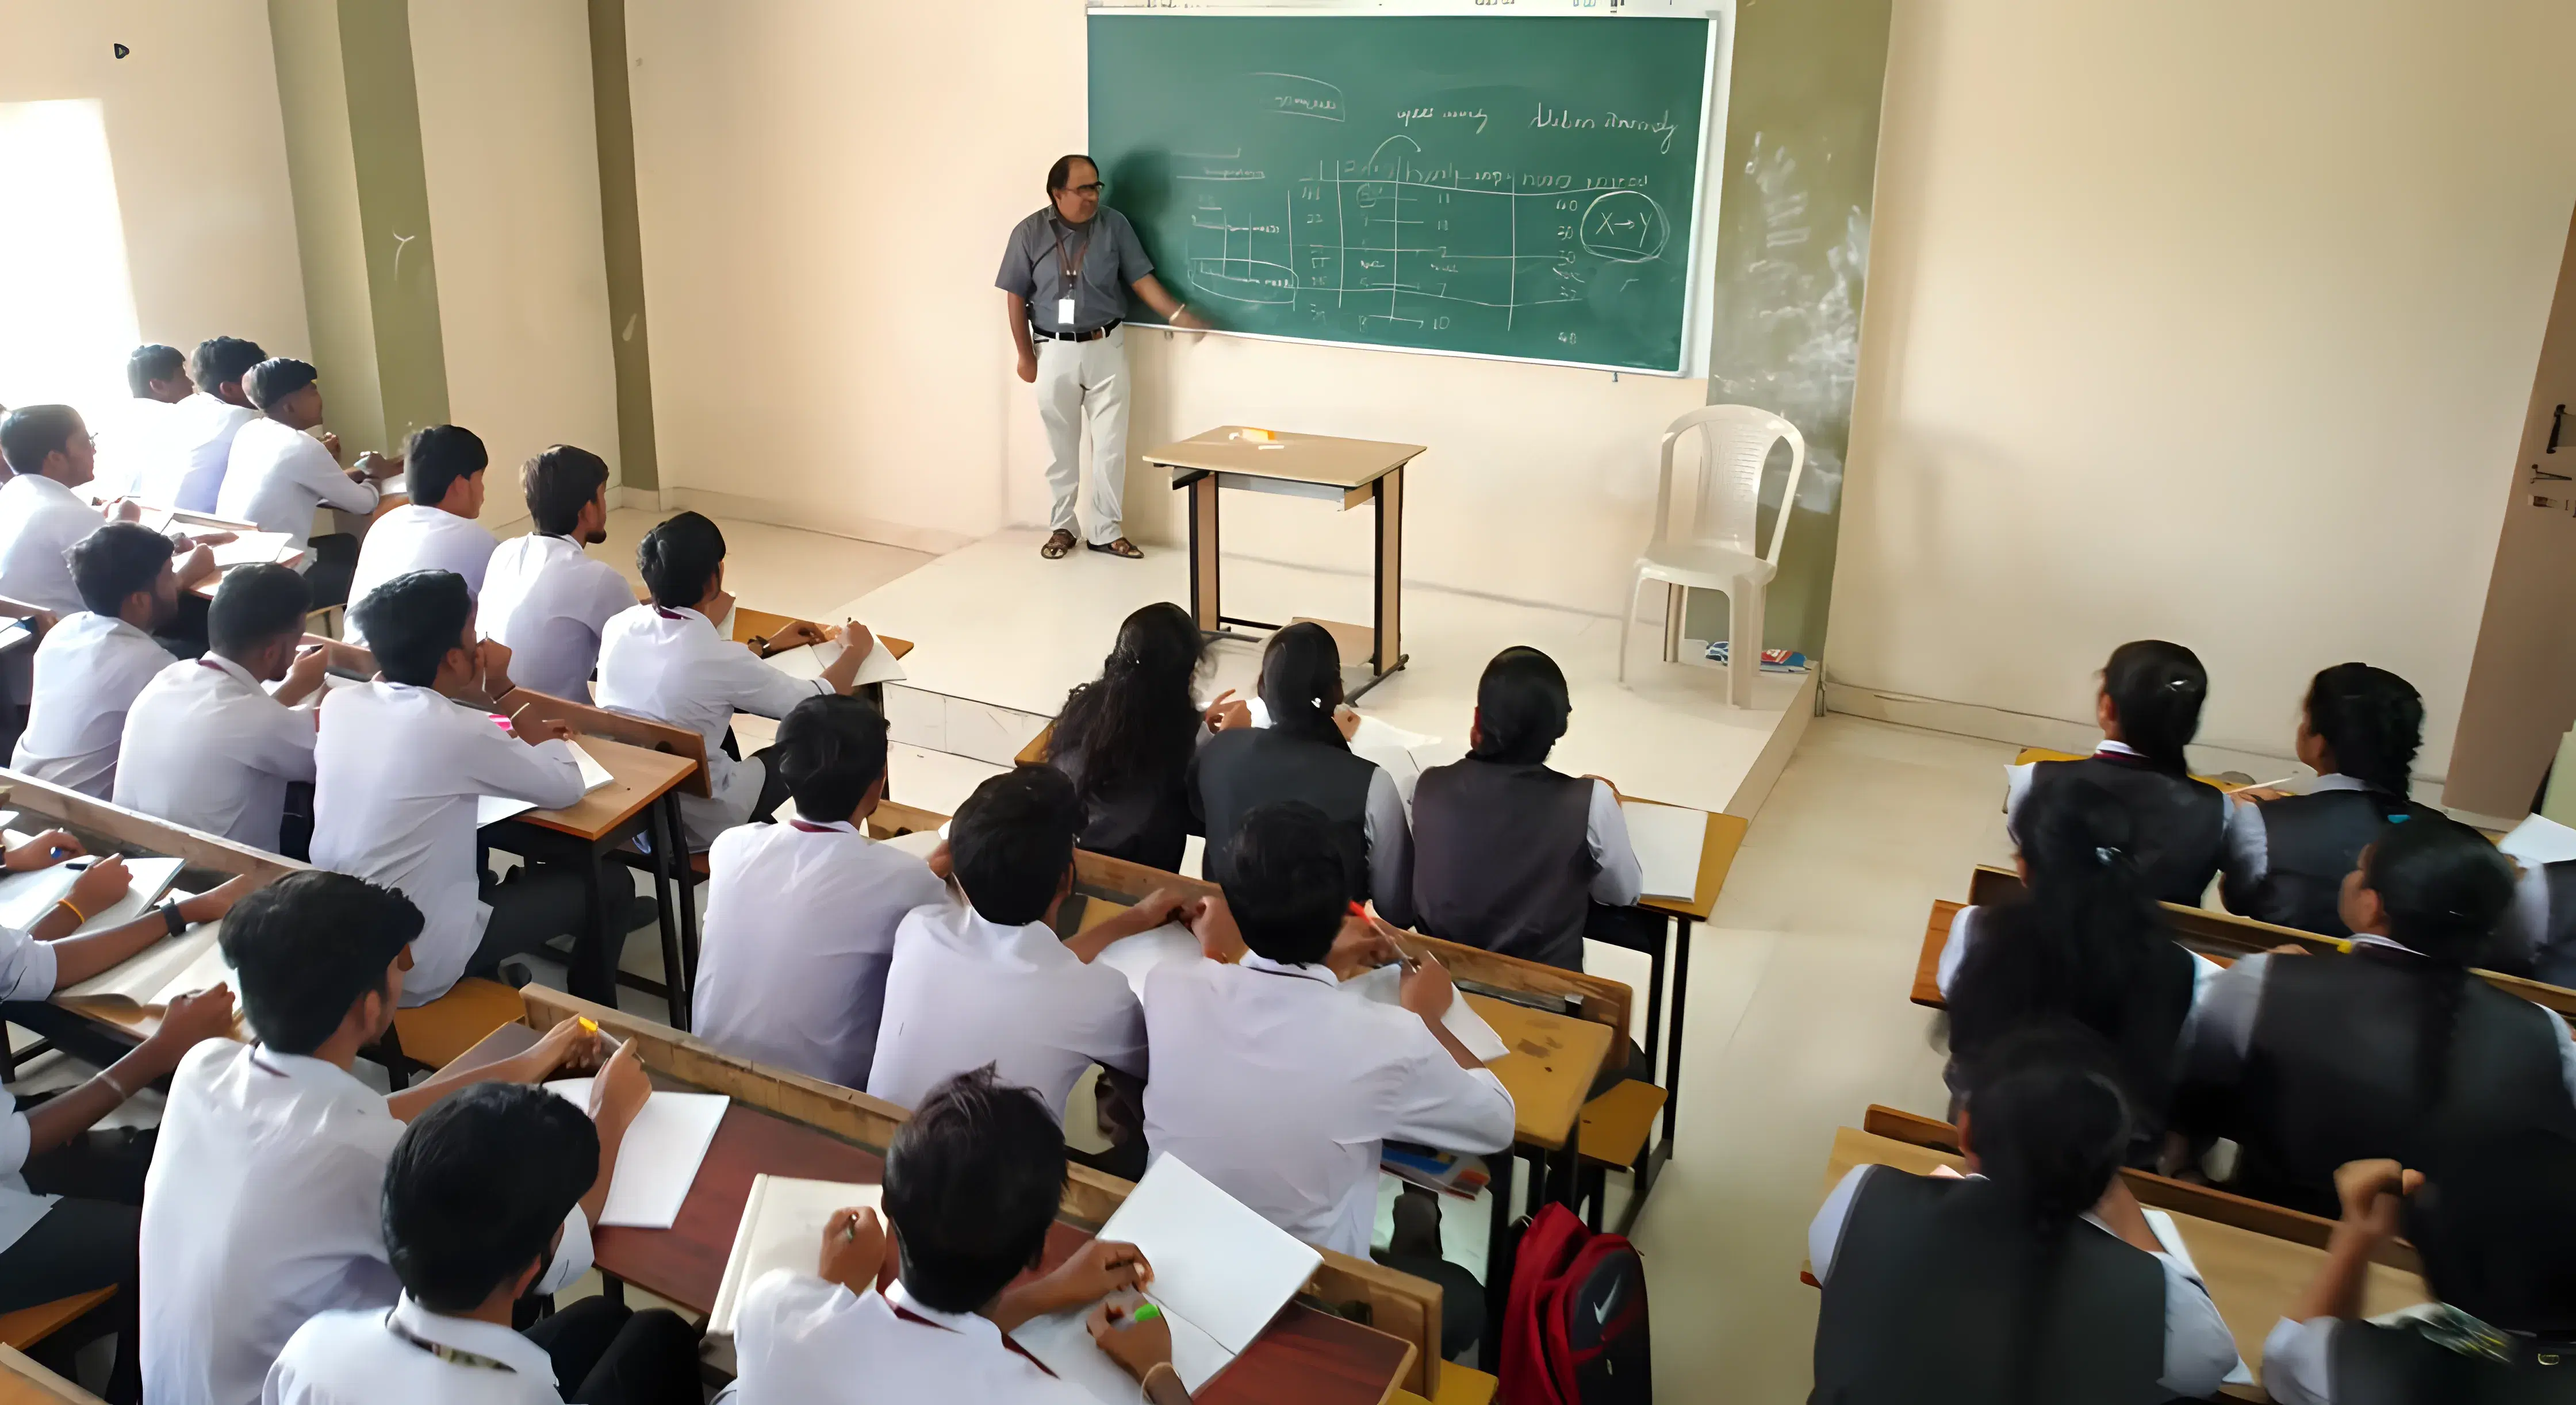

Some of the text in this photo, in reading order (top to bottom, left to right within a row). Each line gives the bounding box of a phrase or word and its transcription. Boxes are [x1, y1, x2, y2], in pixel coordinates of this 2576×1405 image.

[1595, 212, 1654, 248] X Y
[1433, 316, 1451, 329] 10
